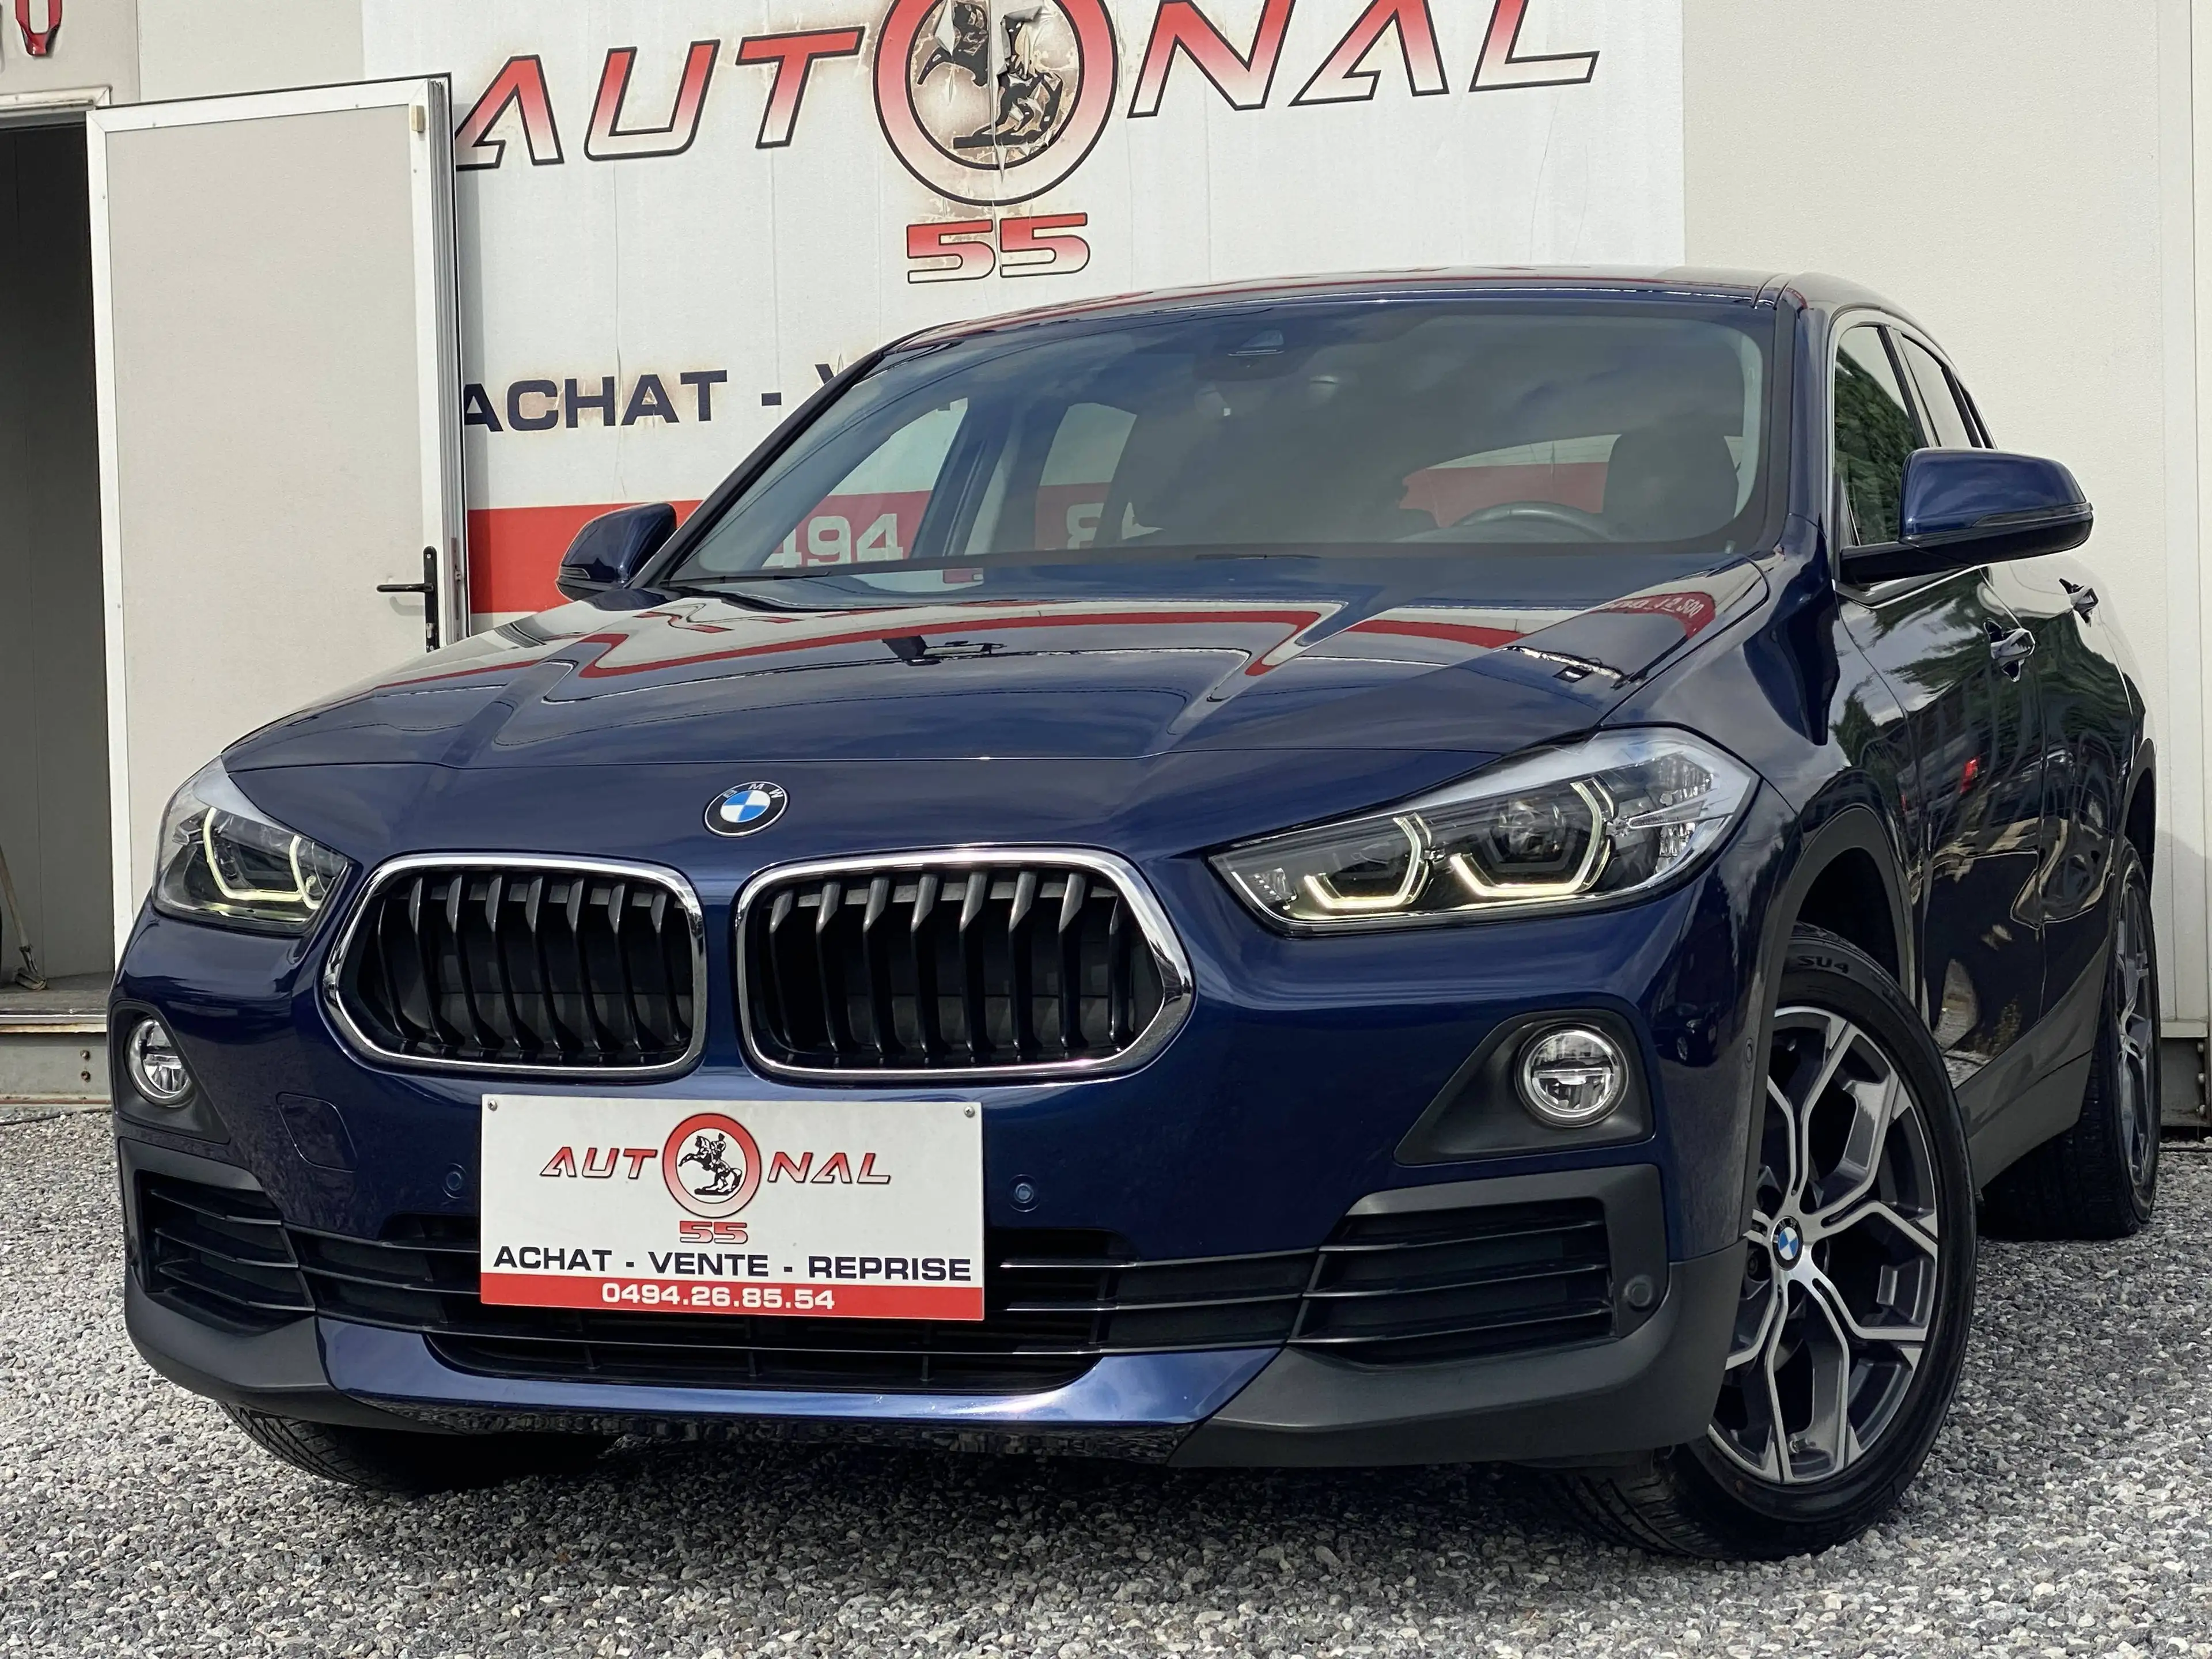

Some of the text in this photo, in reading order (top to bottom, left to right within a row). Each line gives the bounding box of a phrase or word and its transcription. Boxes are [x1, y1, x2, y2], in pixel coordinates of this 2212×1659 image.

[906, 212, 1090, 284] 55
[463, 369, 728, 432] ACHAT
[722, 783, 784, 798] BMW
[1797, 955, 1849, 974] SU4
[679, 1221, 748, 1245] 55
[494, 1247, 612, 1272] ACHAT
[648, 1251, 770, 1278] VENTE
[808, 1255, 972, 1282] REPRISE
[602, 1283, 835, 1310] 0494.26.85.54
